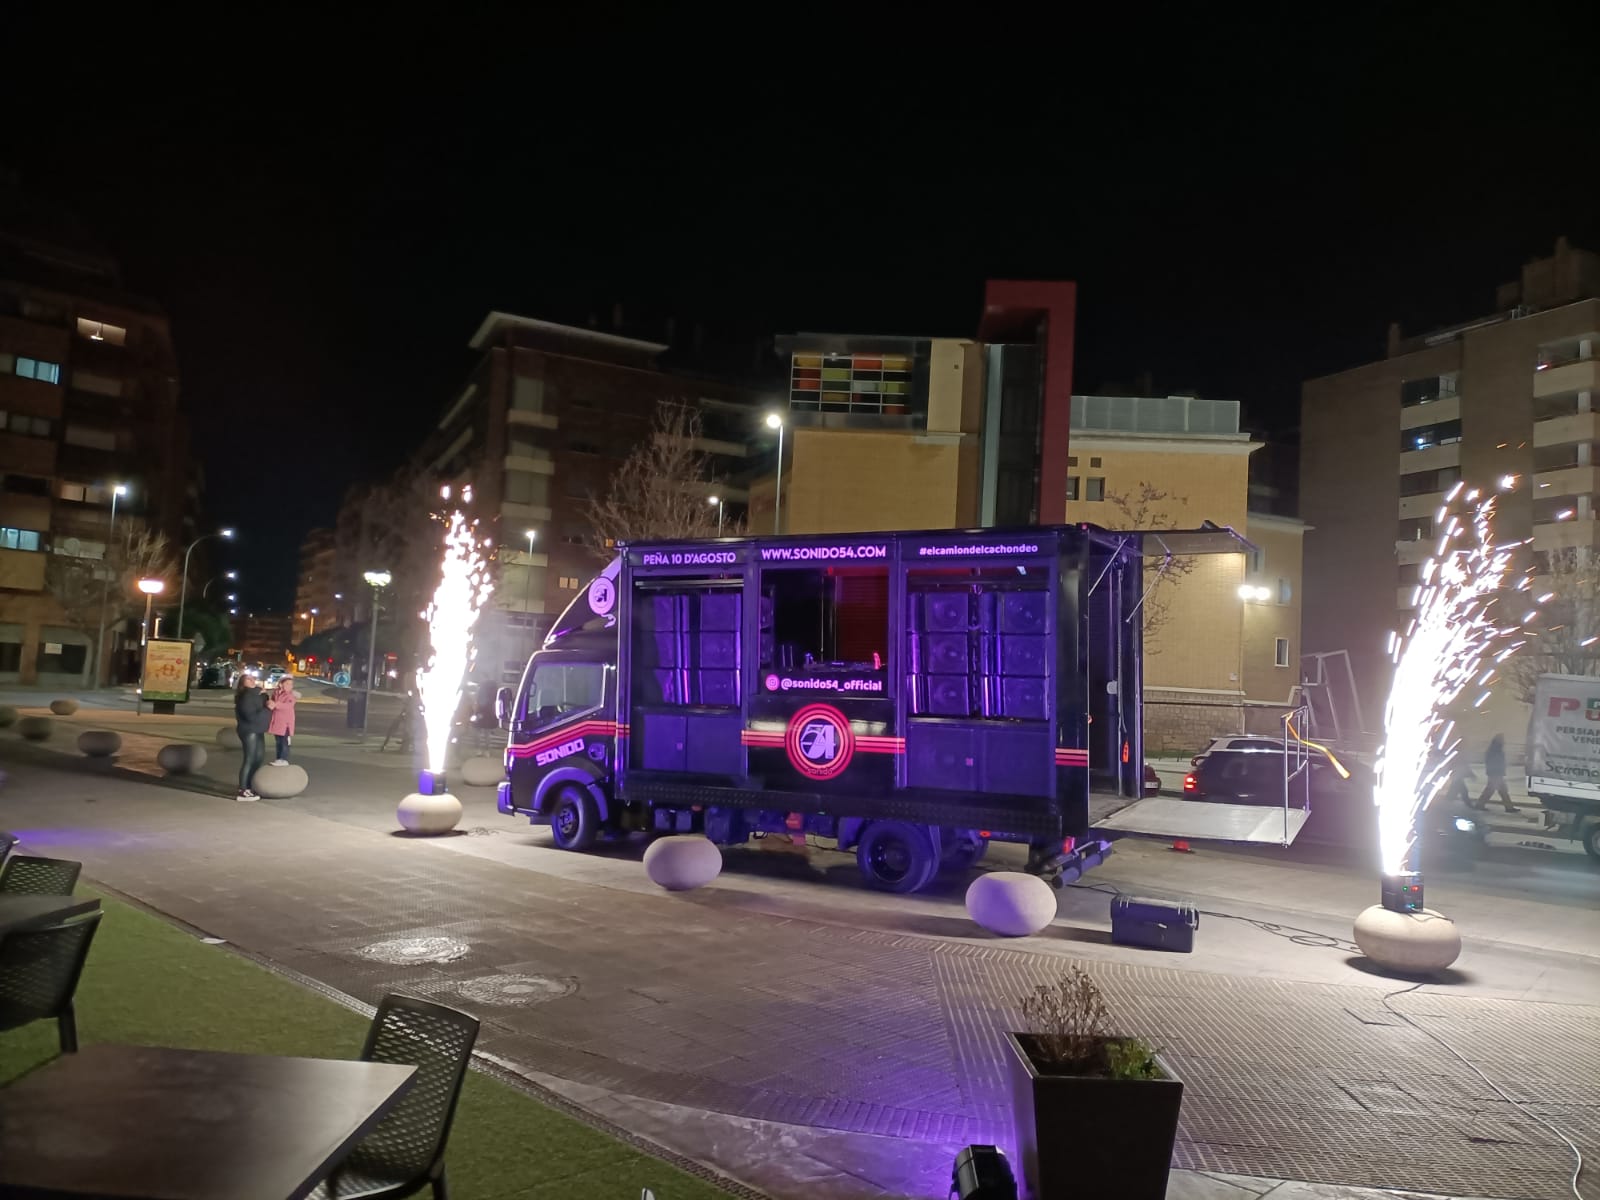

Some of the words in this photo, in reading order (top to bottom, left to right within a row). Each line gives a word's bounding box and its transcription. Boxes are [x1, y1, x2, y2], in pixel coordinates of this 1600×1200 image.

[761, 545, 886, 560] WWW.SONIDO54.COM
[919, 543, 1038, 556] #elcamiondelcachondeo
[643, 552, 669, 565] PEÑA
[672, 554, 681, 565] 10
[684, 552, 736, 564] D'AGOSTO
[780, 678, 882, 692] @sonido54_official
[801, 724, 836, 760] 54
[535, 738, 585, 767] SONIDO
